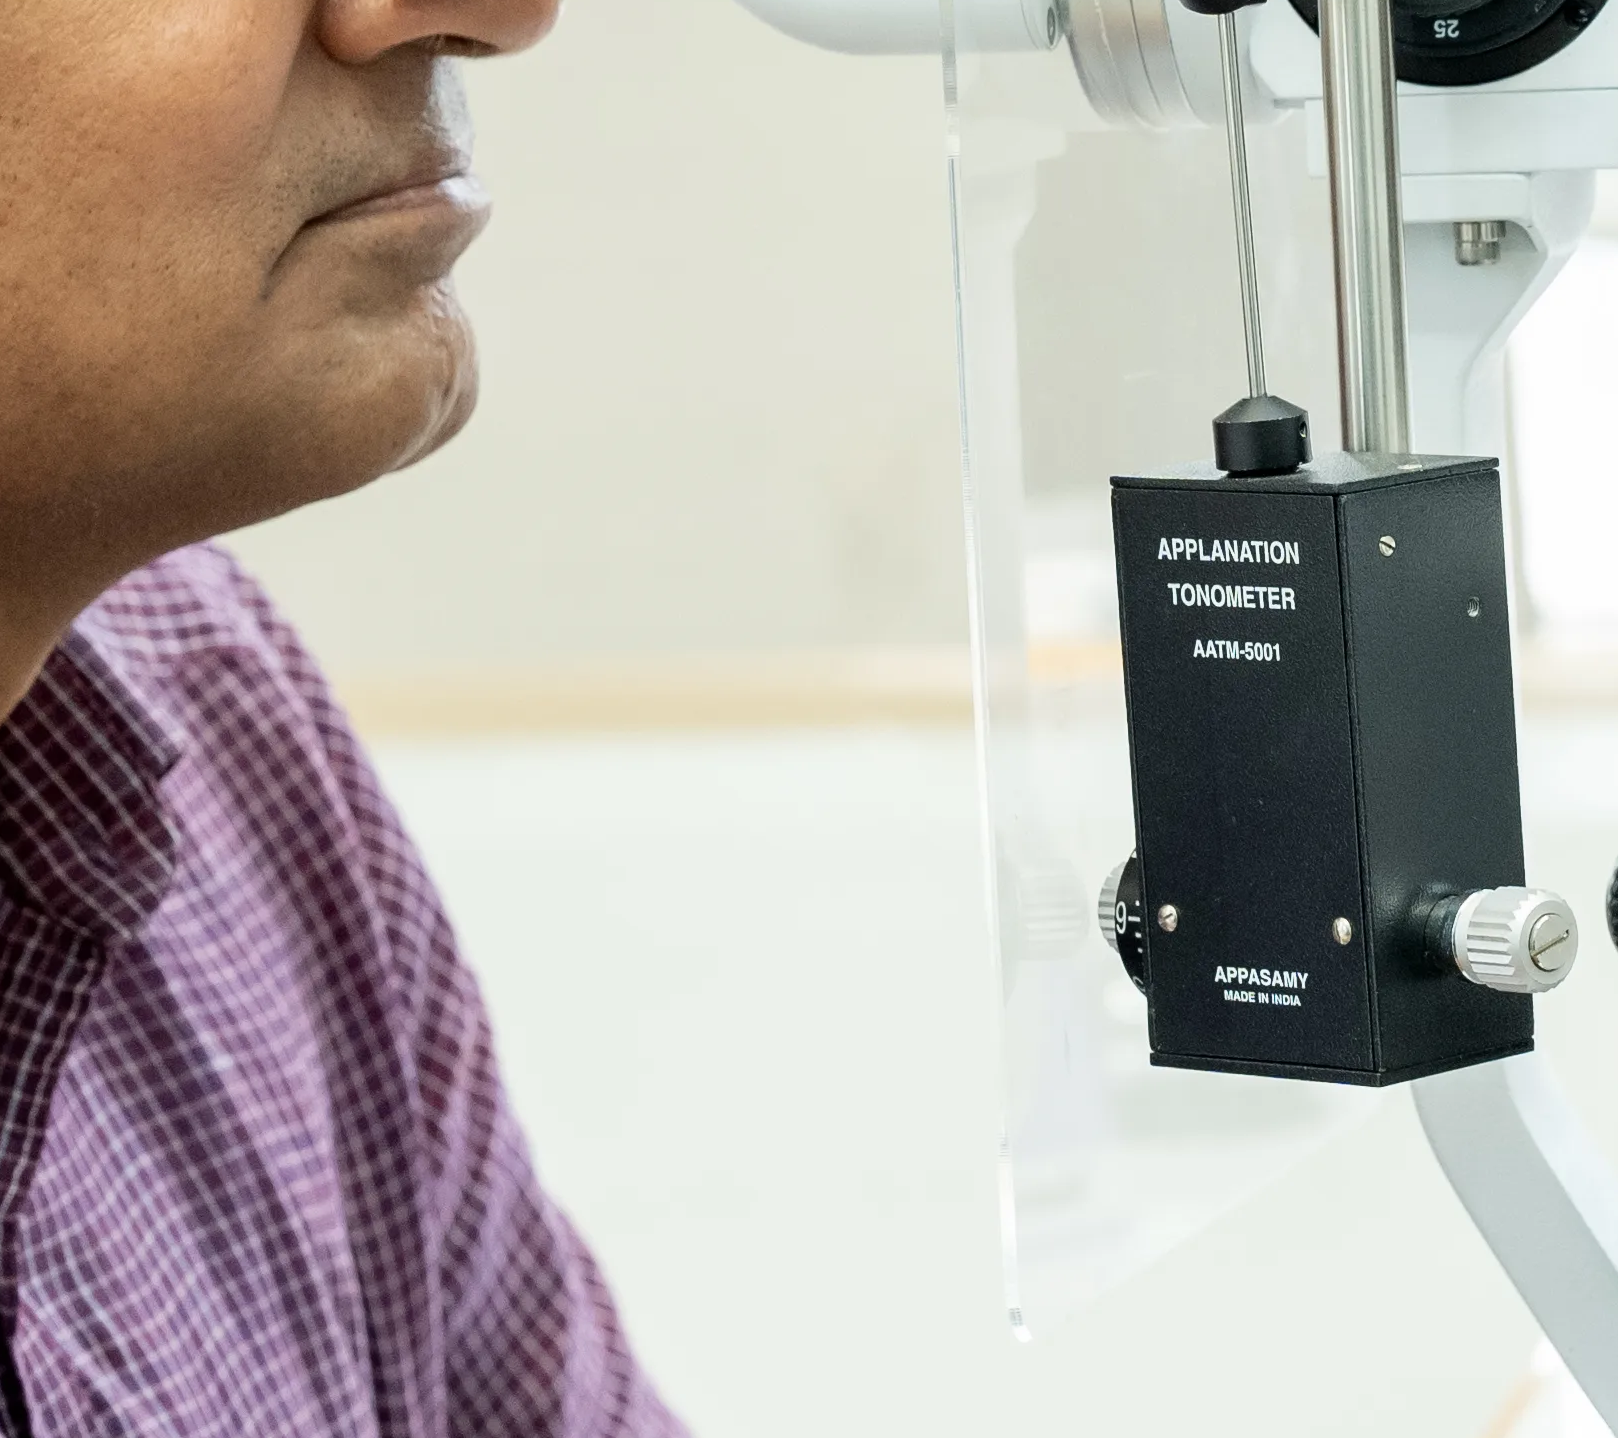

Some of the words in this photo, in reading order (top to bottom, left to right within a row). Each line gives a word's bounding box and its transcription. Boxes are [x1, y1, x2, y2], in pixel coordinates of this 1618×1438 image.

[1433, 18, 1461, 39] 25
[1157, 537, 1300, 565] APPLANATION
[1167, 582, 1296, 610] TONOMETER
[1193, 639, 1281, 662] AATM-5001
[1214, 965, 1309, 989] APPASAMY
[1223, 989, 1256, 1003] MADE
[1258, 992, 1269, 1004] IN
[1271, 993, 1302, 1007] INDIA
